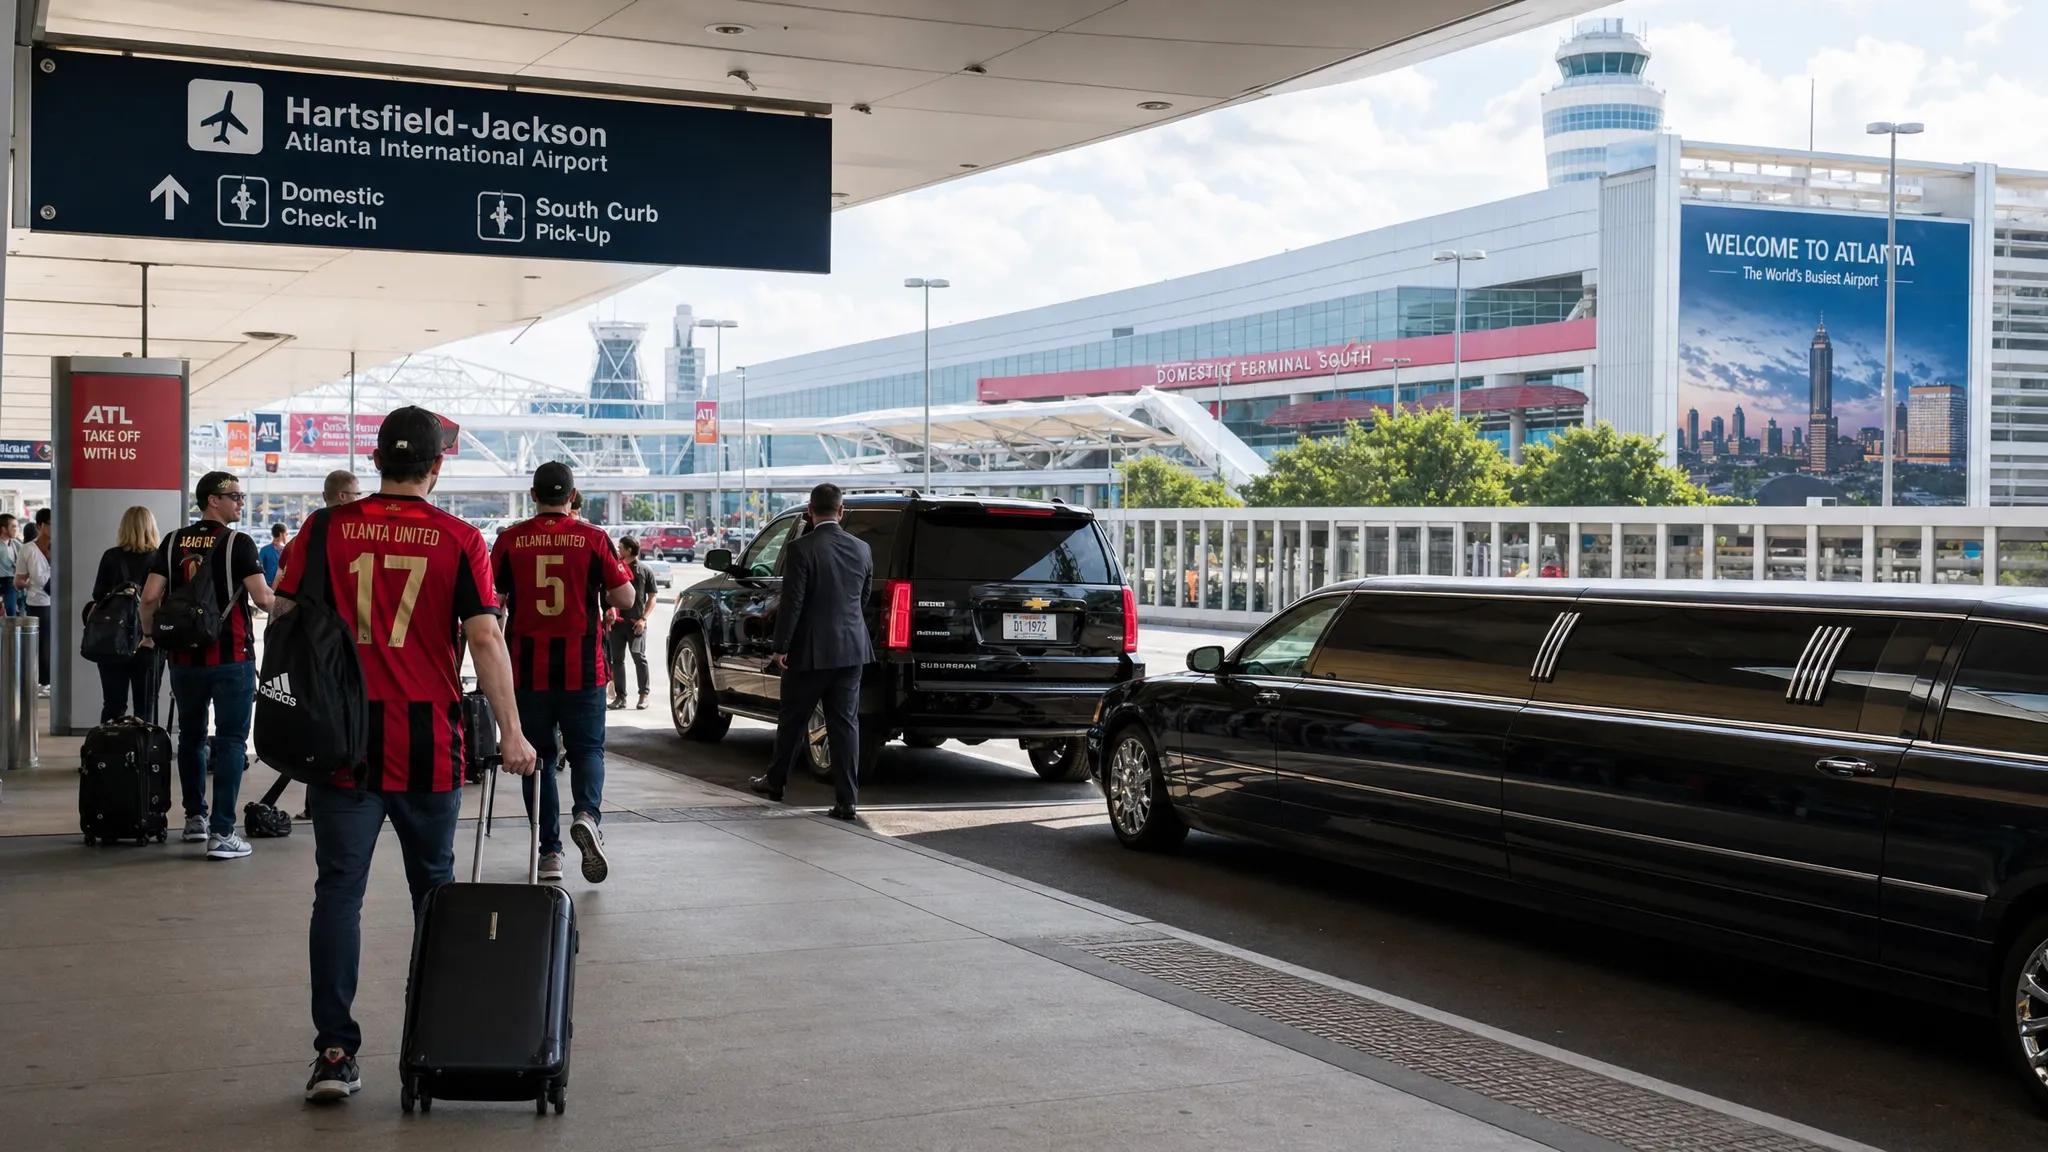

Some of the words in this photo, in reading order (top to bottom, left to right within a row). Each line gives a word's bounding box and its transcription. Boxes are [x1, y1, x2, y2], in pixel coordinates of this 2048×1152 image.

[286, 96, 607, 148] Hartsfield-Jackson
[285, 131, 371, 156] Atlanta
[380, 138, 524, 167] International
[532, 149, 608, 174] Airport
[281, 181, 385, 206] Domestic
[281, 207, 377, 230] Check-In
[536, 197, 599, 219] South
[607, 201, 659, 223] Curb
[536, 223, 611, 247] Pick-Up
[1705, 232, 1799, 260] WELCOME
[1805, 239, 1829, 261] TO
[1743, 266, 1762, 280] The
[1765, 267, 1802, 282] World's
[1805, 270, 1841, 286] Busiest
[1843, 272, 1879, 290] Airport
[1319, 349, 1371, 369] SOUTH
[83, 405, 133, 425] ATL
[83, 430, 115, 442] TAKE
[118, 430, 141, 443] OFF
[257, 421, 280, 438] ATL
[83, 447, 117, 460] WITH
[120, 447, 137, 460] US
[394, 526, 440, 546] UNITED
[515, 534, 552, 549] ATLANTA
[554, 534, 586, 548] UNITED
[536, 555, 565, 616] 5
[349, 552, 428, 648] 17
[1028, 621, 1047, 633] 1972
